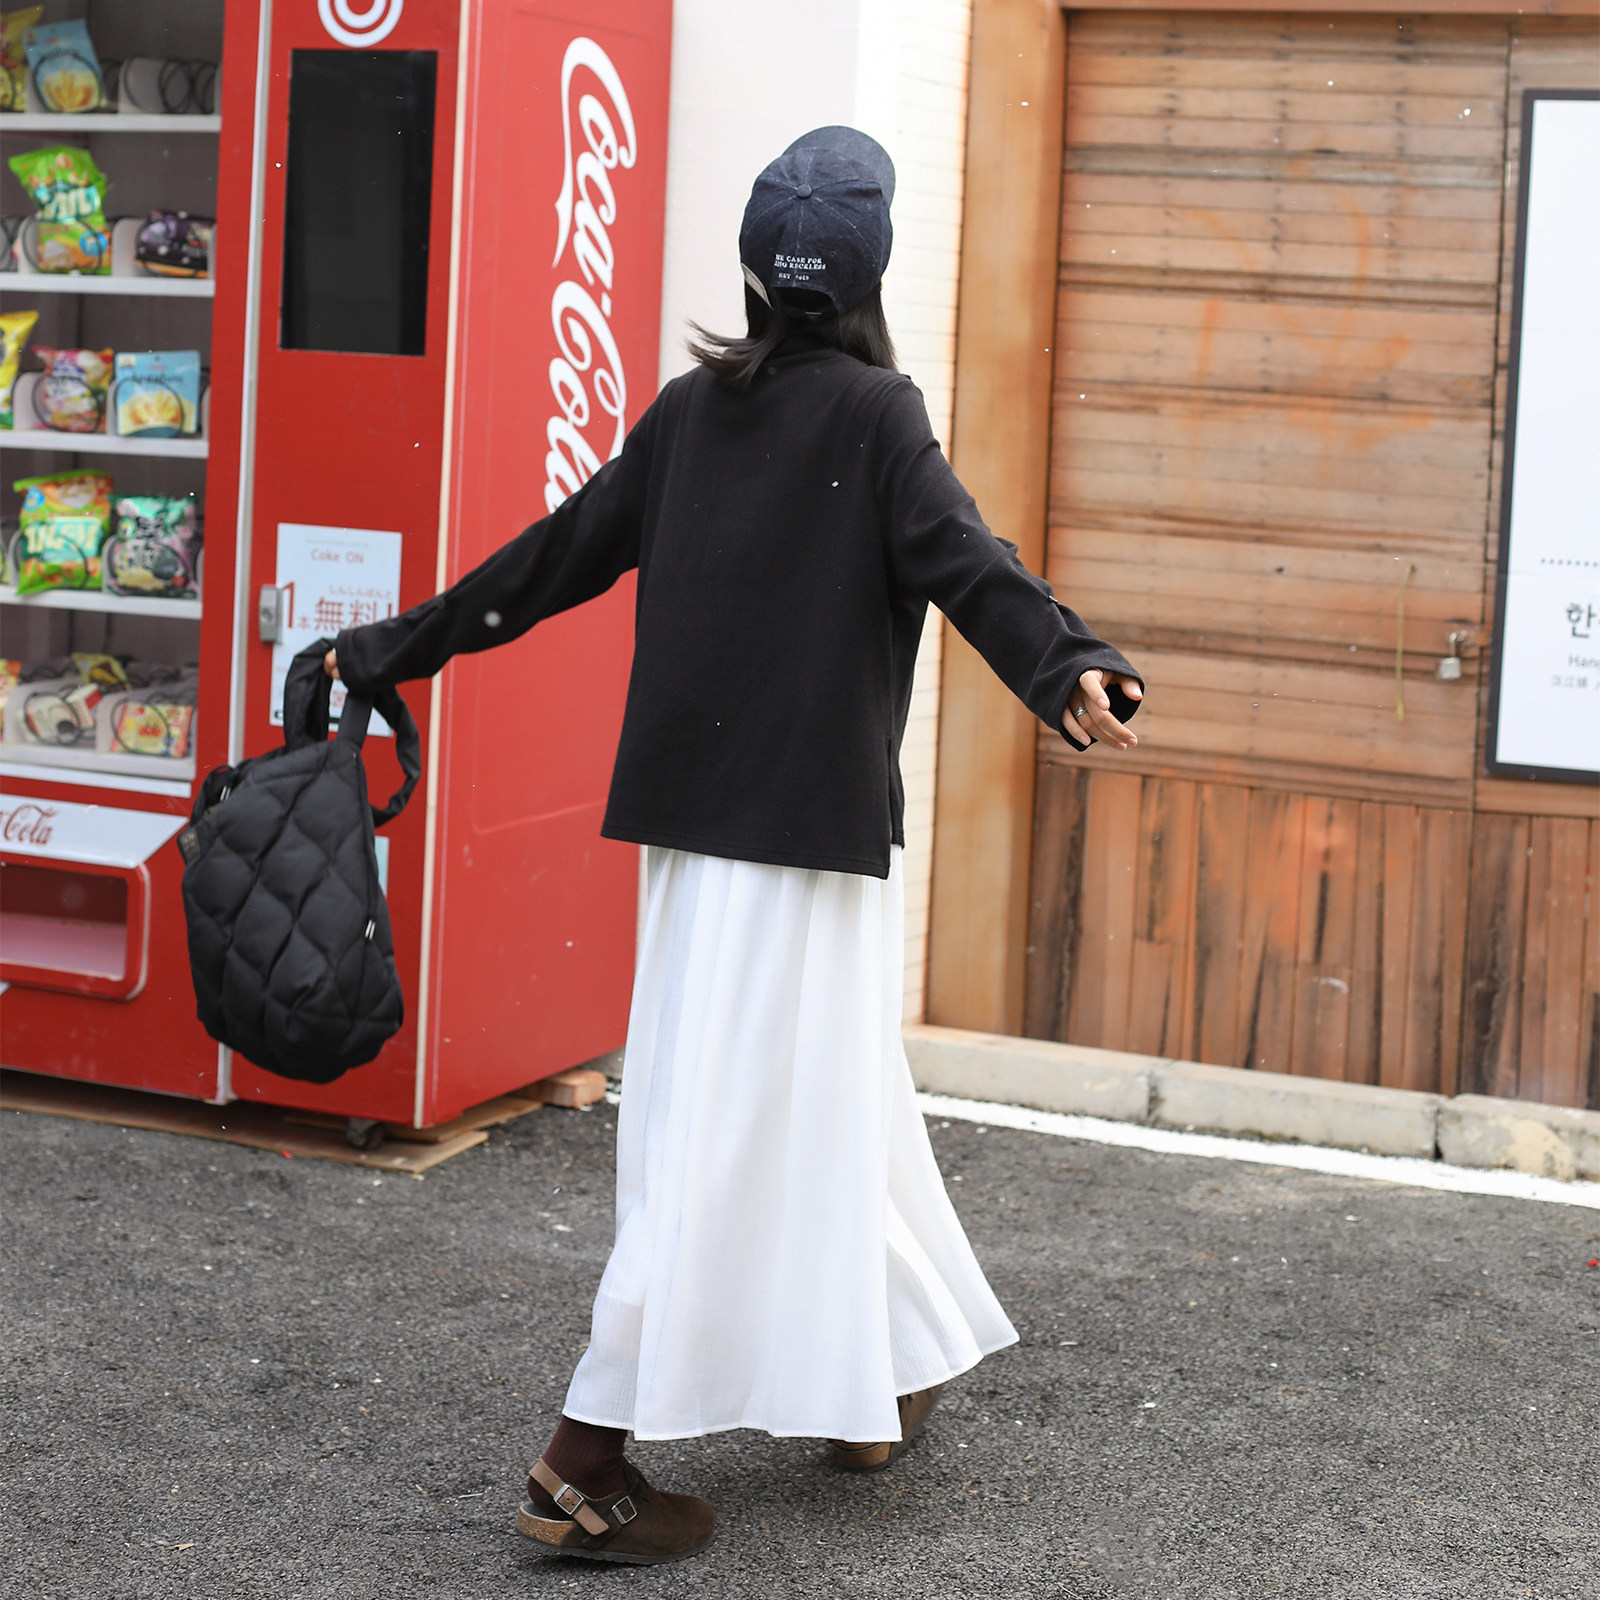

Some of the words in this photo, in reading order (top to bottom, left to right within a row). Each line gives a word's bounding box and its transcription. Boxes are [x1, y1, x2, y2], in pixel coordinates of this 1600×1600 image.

[310, 547, 341, 563] Coke
[345, 550, 365, 565] ON
[1566, 603, 1600, 638] 한
